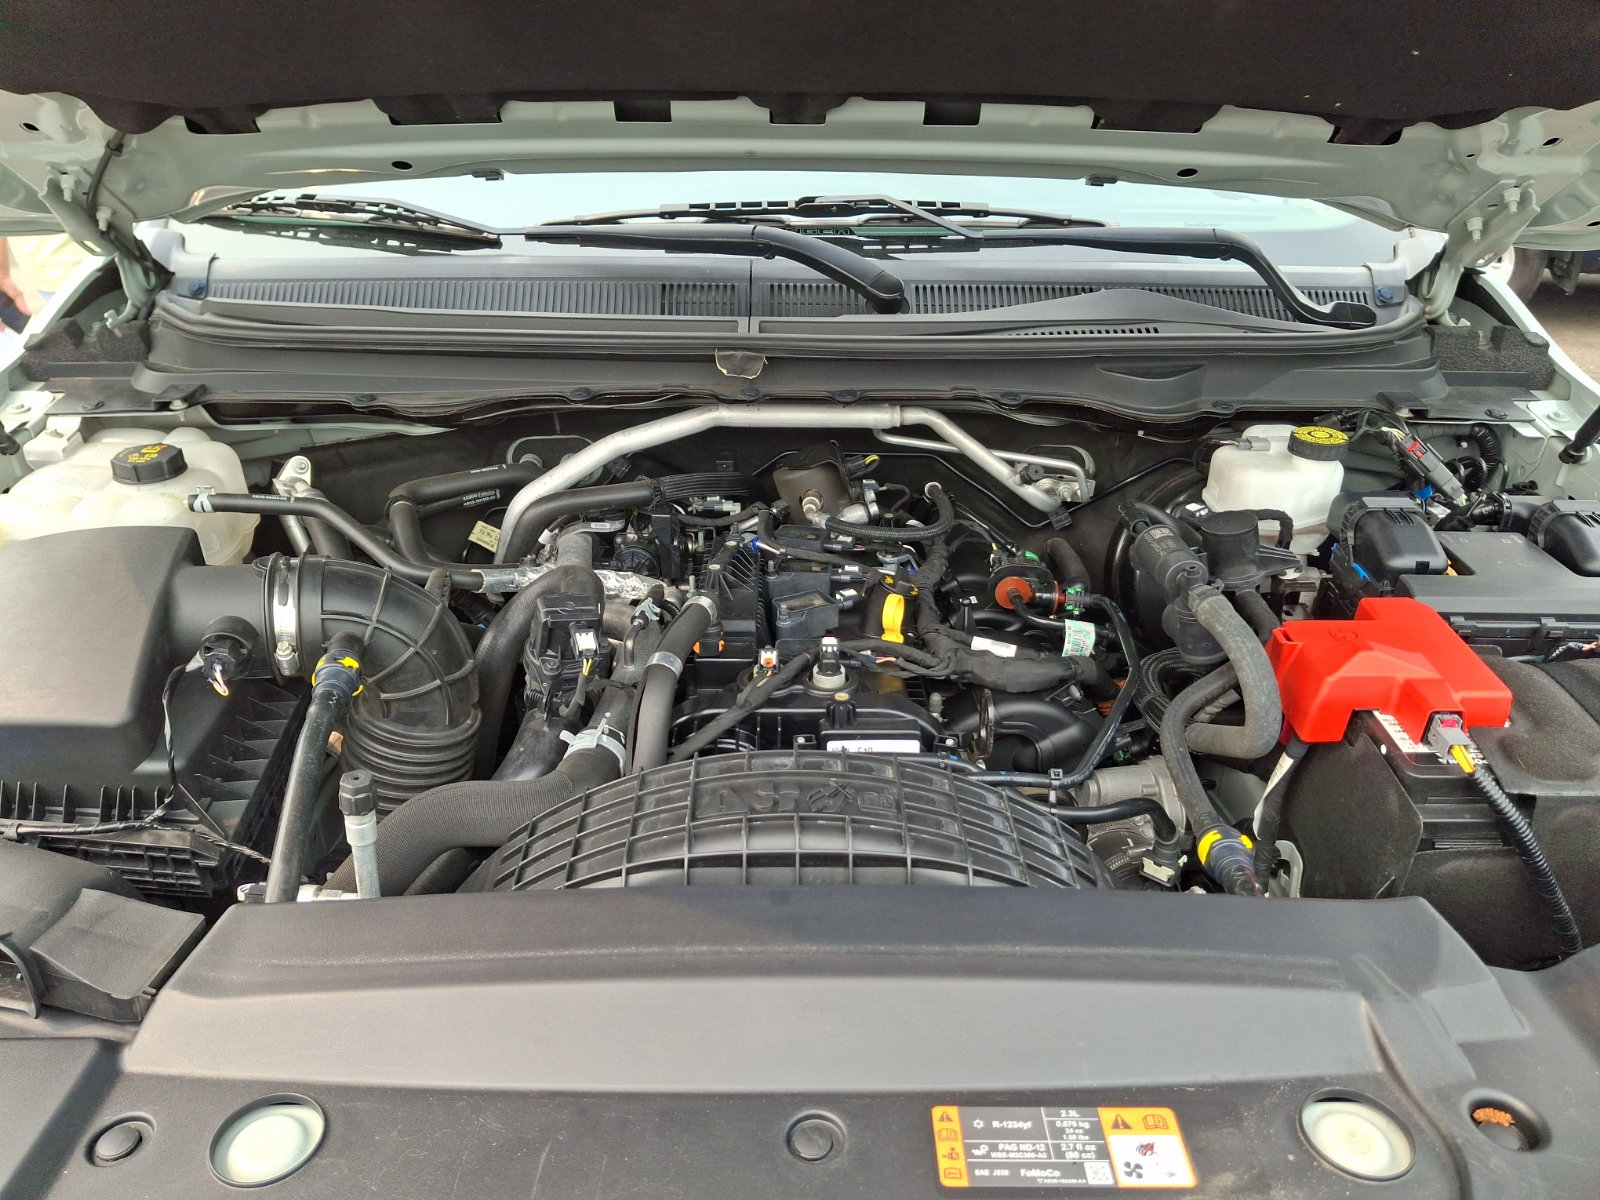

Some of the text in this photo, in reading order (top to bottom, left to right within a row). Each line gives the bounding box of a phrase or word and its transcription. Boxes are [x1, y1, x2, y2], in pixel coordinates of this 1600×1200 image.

[992, 1120, 1032, 1130] R-1234yf
[1078, 1120, 1090, 1129] kg
[998, 1143, 1046, 1151] PAG ND-12
[1060, 1143, 1074, 1151] 2.7
[1075, 1143, 1083, 1151] fl
[1020, 1168, 1061, 1177] FoMoCo
